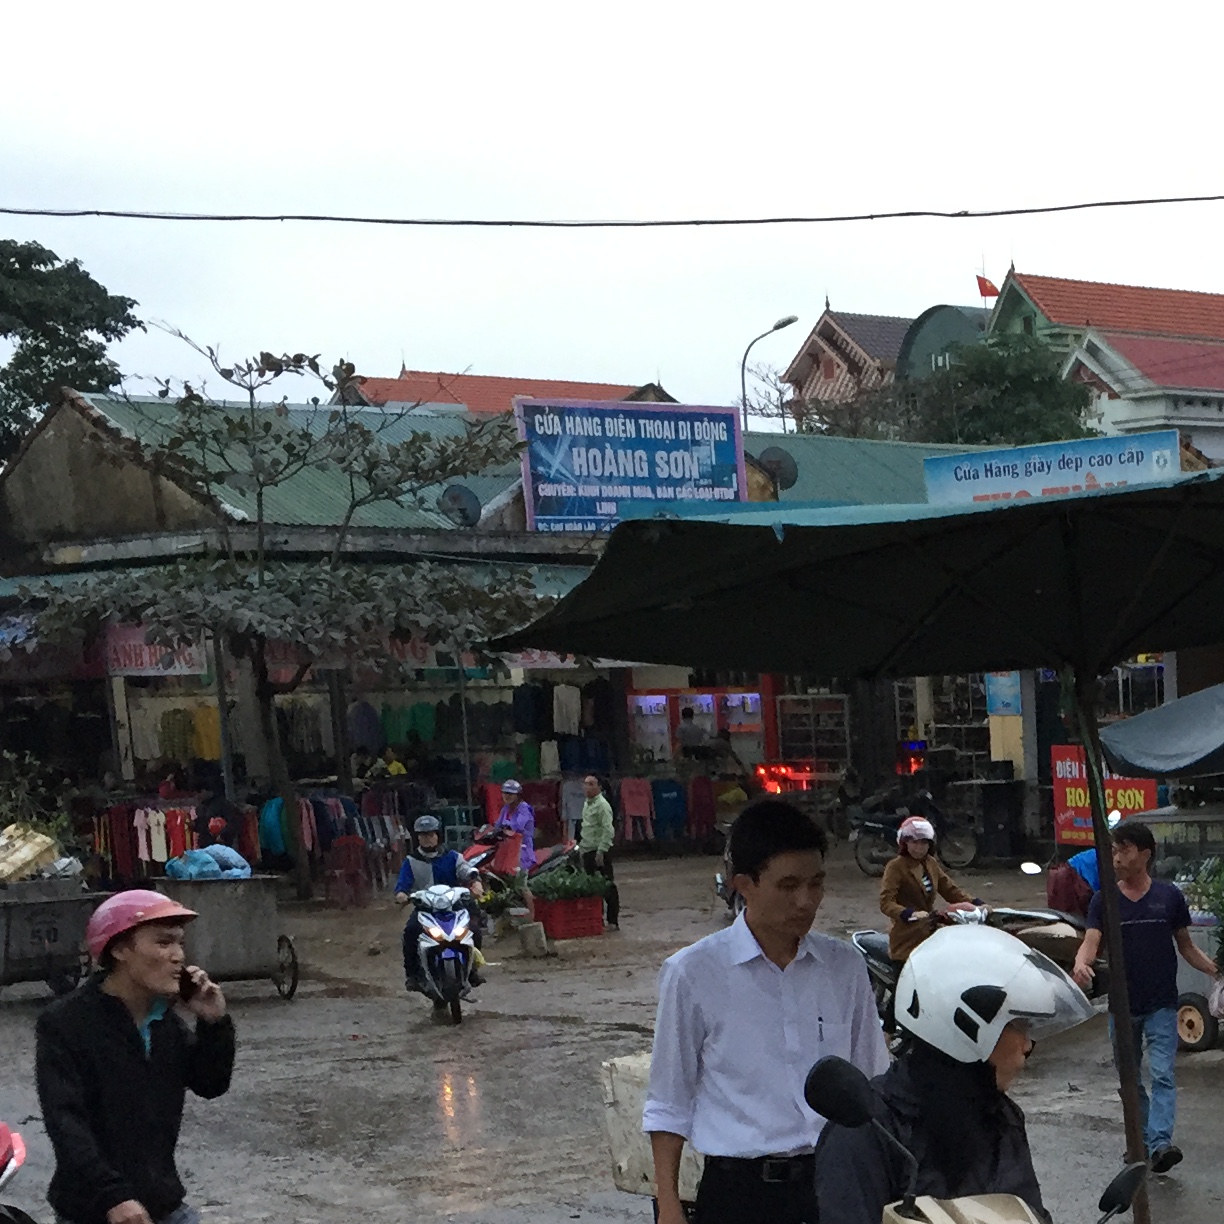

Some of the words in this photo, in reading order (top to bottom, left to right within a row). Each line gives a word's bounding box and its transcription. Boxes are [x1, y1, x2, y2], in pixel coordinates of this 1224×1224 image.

[604, 413, 636, 442] ĐIỆN
[638, 419, 676, 444] THOẠI
[572, 443, 650, 479] HOÀNG
[655, 449, 700, 479] SƠN
[1088, 453, 1113, 467] cao
[1056, 757, 1080, 783] ĐIỆN
[1066, 787, 1114, 809] HOG
[1116, 787, 1145, 809] SƠN
